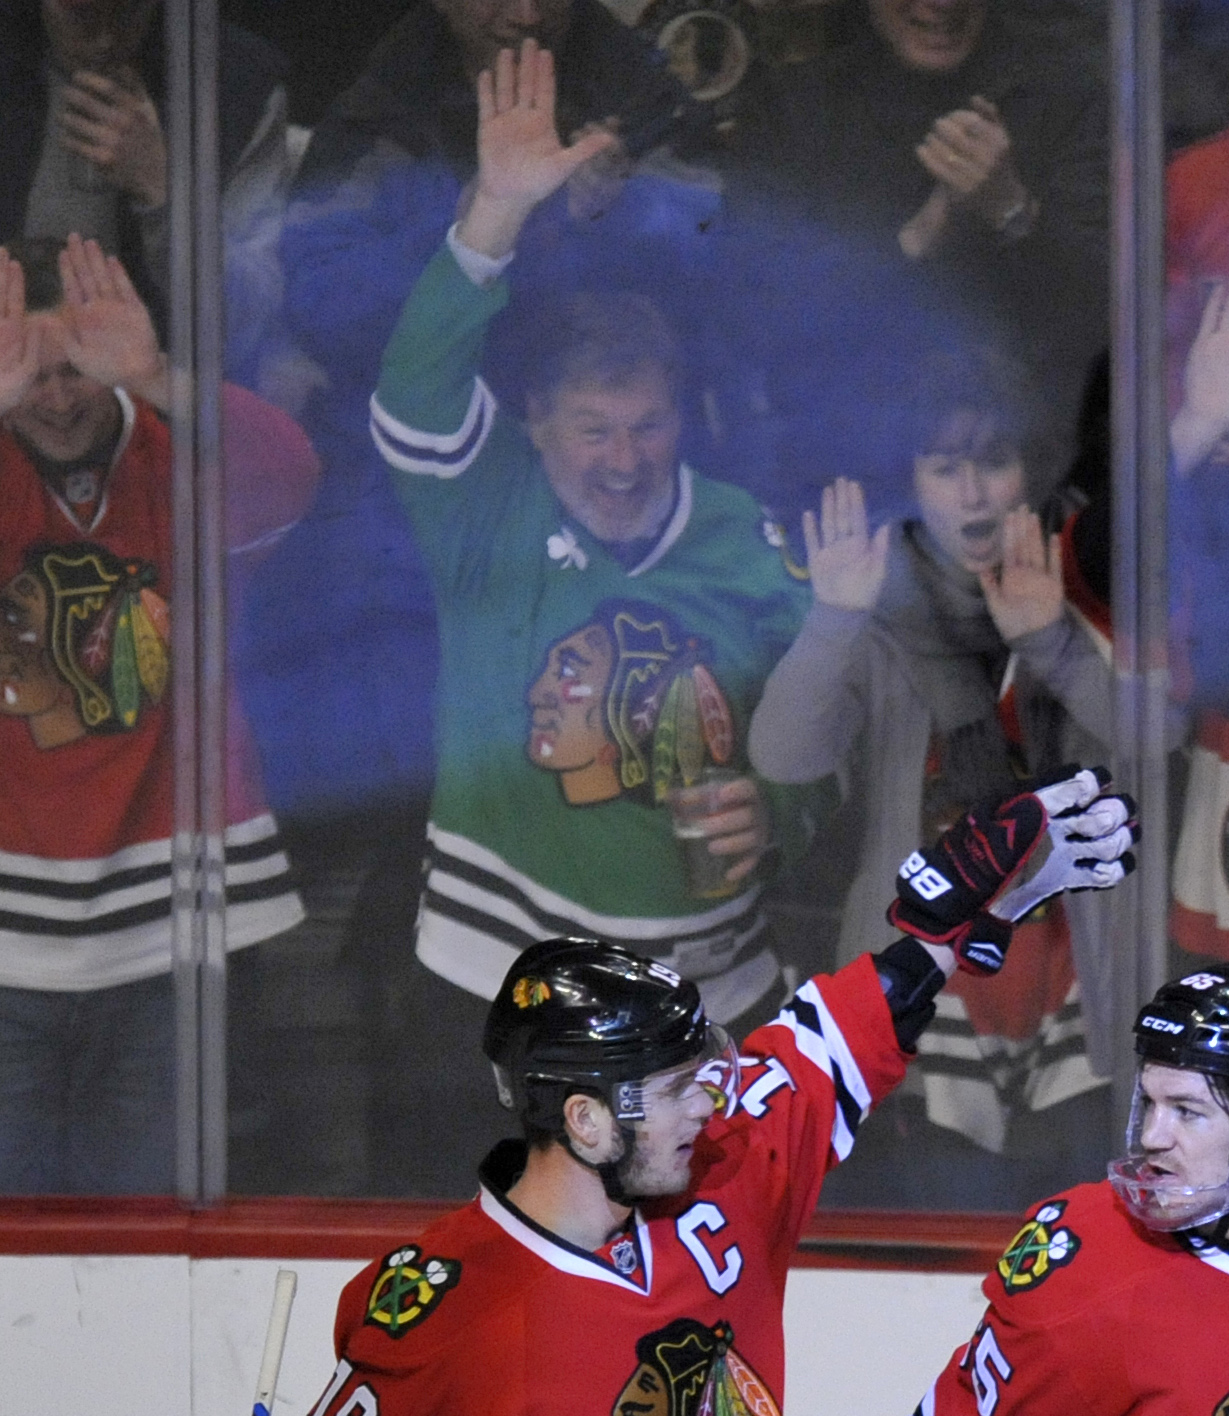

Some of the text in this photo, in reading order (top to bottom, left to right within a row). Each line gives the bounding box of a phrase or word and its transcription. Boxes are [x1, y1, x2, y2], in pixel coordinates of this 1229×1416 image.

[1179, 972, 1226, 991] 65
[1141, 1016, 1185, 1035] CCM
[677, 1201, 744, 1295] C
